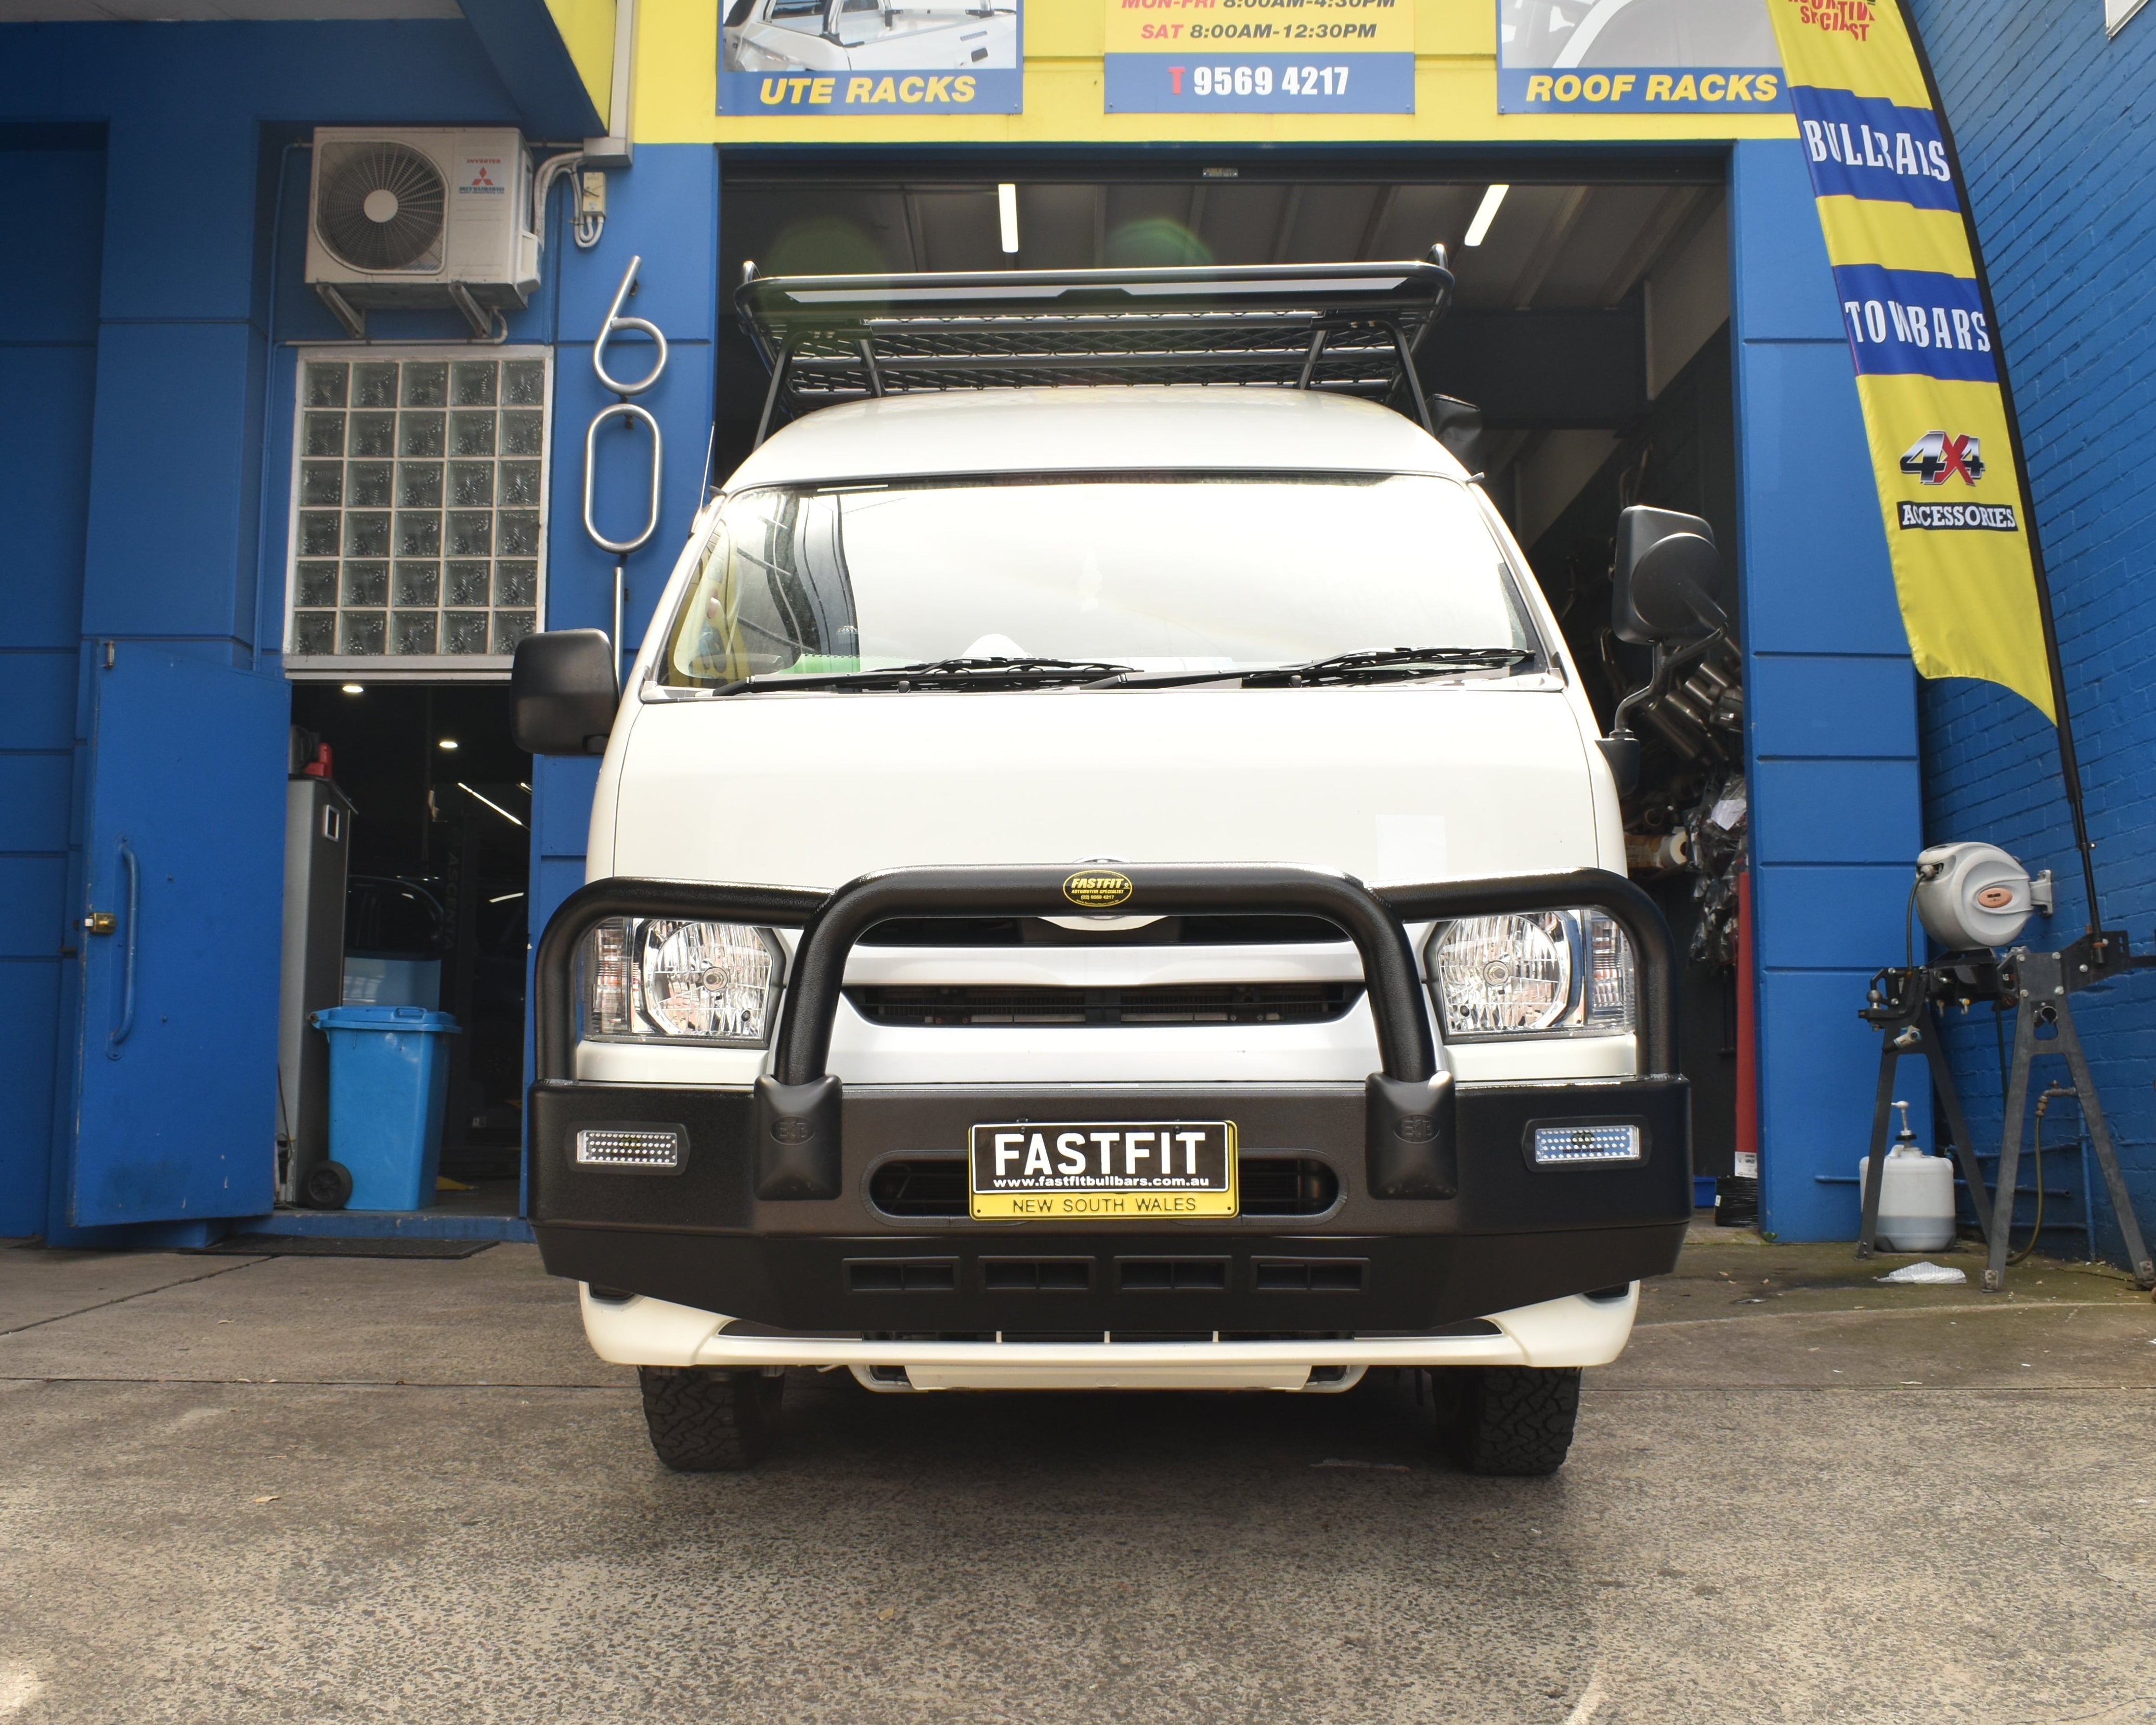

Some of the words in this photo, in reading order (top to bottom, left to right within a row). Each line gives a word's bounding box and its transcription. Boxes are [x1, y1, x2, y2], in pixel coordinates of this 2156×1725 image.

[1141, 24, 1184, 38] SAT
[1189, 24, 1378, 38] 8:00AM-12:30PM
[760, 77, 836, 105] UTE
[845, 75, 976, 103] RACKS
[1168, 67, 1185, 95] T
[1193, 66, 1273, 96] 9569
[1281, 66, 1349, 96] 4217
[1526, 74, 1637, 102] ROOF
[1645, 74, 1778, 101] RACKS
[1844, 300, 1991, 352] TOWBARS
[1071, 878, 1124, 889] FASTFIT
[994, 1132, 1206, 1176] FASTFIT
[993, 1176, 1210, 1188] www.fastfitbullbars.com.au
[1012, 1199, 1054, 1213] NEW
[1063, 1198, 1124, 1212] SOUTH
[1136, 1198, 1197, 1212] WALES
